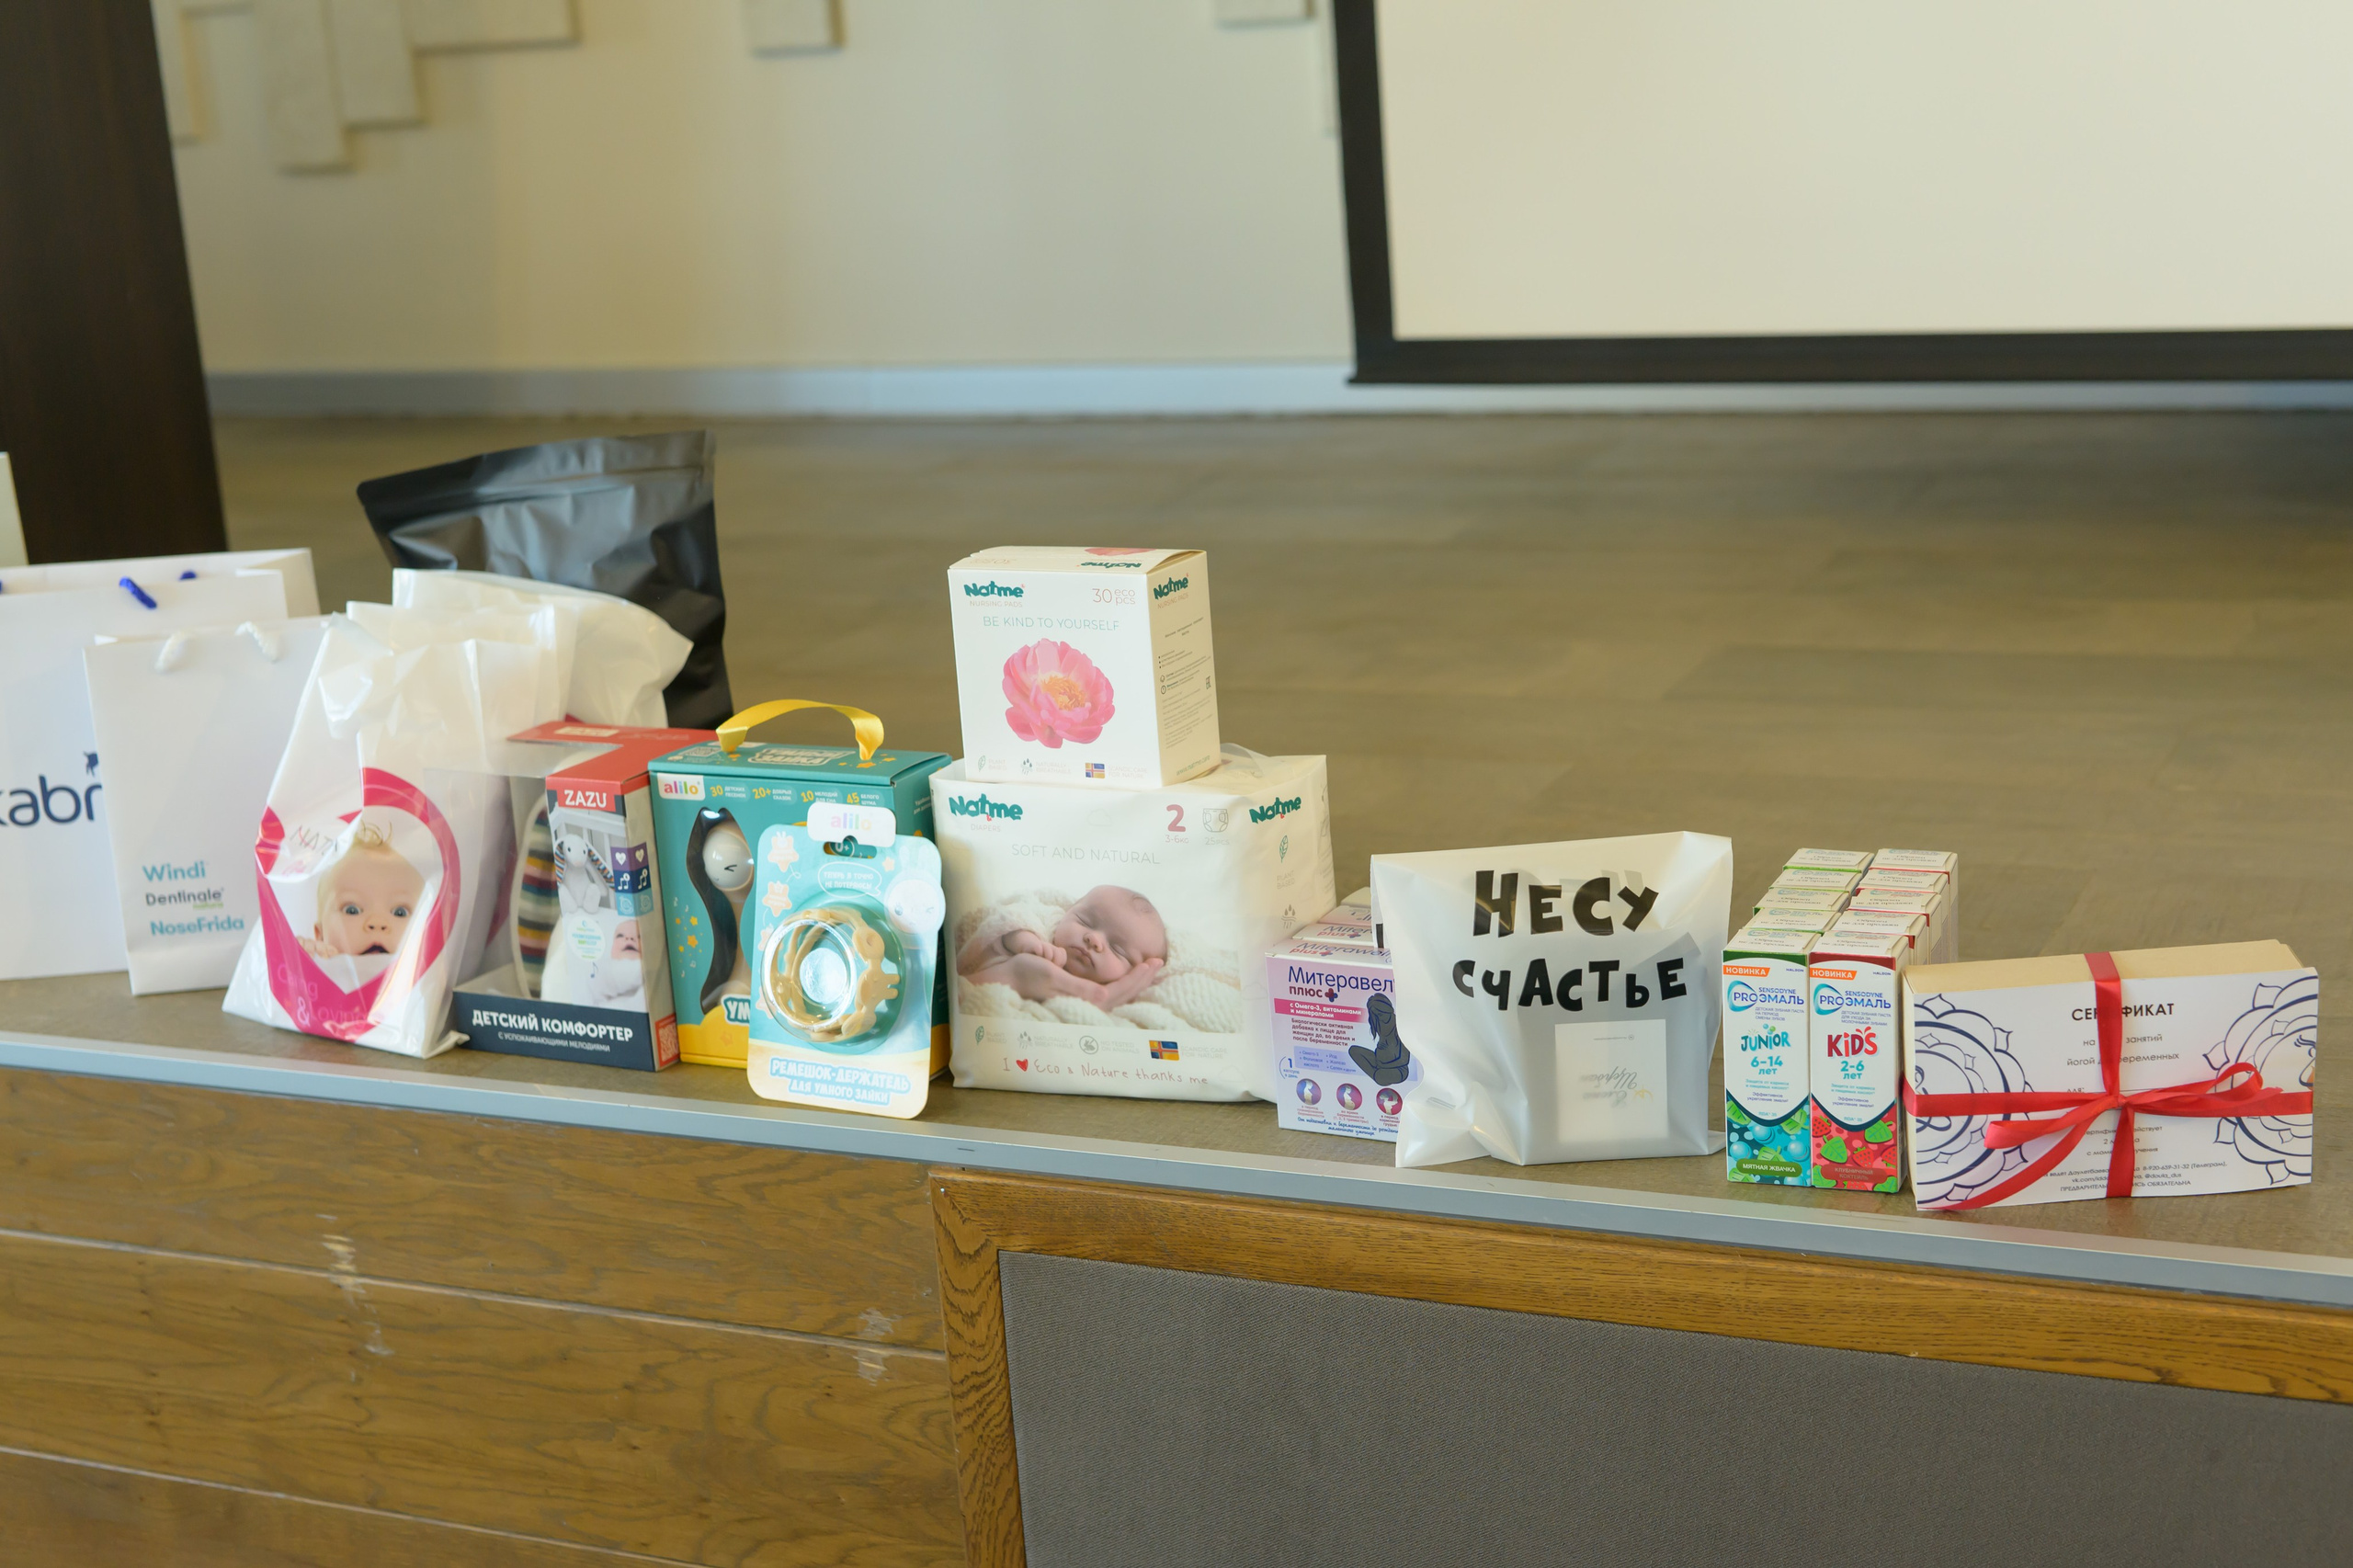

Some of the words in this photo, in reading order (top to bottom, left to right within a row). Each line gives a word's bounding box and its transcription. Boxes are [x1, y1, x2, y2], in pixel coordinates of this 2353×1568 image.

[963, 580, 1024, 597] Natme
[1092, 588, 1113, 603] 30
[1154, 577, 1188, 600] Natme
[1115, 597, 1136, 606] pcs
[983, 616, 999, 627] BE
[1003, 617, 1034, 628] KIND
[1037, 618, 1053, 629] TO
[1056, 618, 1119, 631] YOURSELF
[664, 780, 699, 795] alilo
[710, 785, 723, 797] 30
[752, 787, 771, 800] 20+
[564, 790, 607, 808] ZAZU
[801, 790, 814, 802] 10
[847, 792, 859, 804] 45
[949, 793, 1023, 821] Natme
[1249, 797, 1302, 824] Natme
[831, 812, 872, 831] alilo
[1165, 803, 1187, 833] 2
[971, 824, 1001, 833] DIAPERS
[1011, 844, 1047, 858] SOFT
[1051, 846, 1085, 860] AND
[1090, 848, 1161, 865] NATURAL
[142, 860, 206, 882] Windi
[1472, 869, 1659, 937] НЕСУ
[150, 915, 244, 936] NoseFrida
[1726, 967, 1766, 975] НОВИНКА
[1812, 970, 1853, 978] НОВИНКА
[1289, 965, 1393, 993] Митеравел
[1452, 957, 1688, 1012] СЧАСТЬЕ
[1289, 986, 1323, 998] плюс
[1296, 1009, 1335, 1018] минералами
[472, 1009, 539, 1031] ДЕТСКИЙ
[541, 1017, 633, 1041] КОМФОРТЕР
[1291, 1018, 1327, 1027] Биологически
[569, 1040, 610, 1052] МЕЛОДИЯМИ
[1309, 1037, 1348, 1047] беременности
[2126, 1034, 2163, 1044] занятий
[1288, 1058, 1292, 1068] 1
[1840, 1060, 1864, 1072] 2-6
[2067, 1057, 2095, 1066] йогой
[770, 1059, 910, 1091] РЕМЕШОК-ДЕРЖАТЕЛЬ
[1003, 1057, 1010, 1072] I
[1034, 1058, 1060, 1074] Eco
[1081, 1062, 1129, 1078] Nature
[1135, 1068, 1183, 1083] thanks
[1189, 1076, 1209, 1085] me
[790, 1079, 811, 1092] ДЛЯ
[813, 1083, 853, 1098] УМНОГО
[855, 1088, 888, 1103] ЗАЙКИ
[1768, 1165, 1796, 1173] ЖВАЧКА
